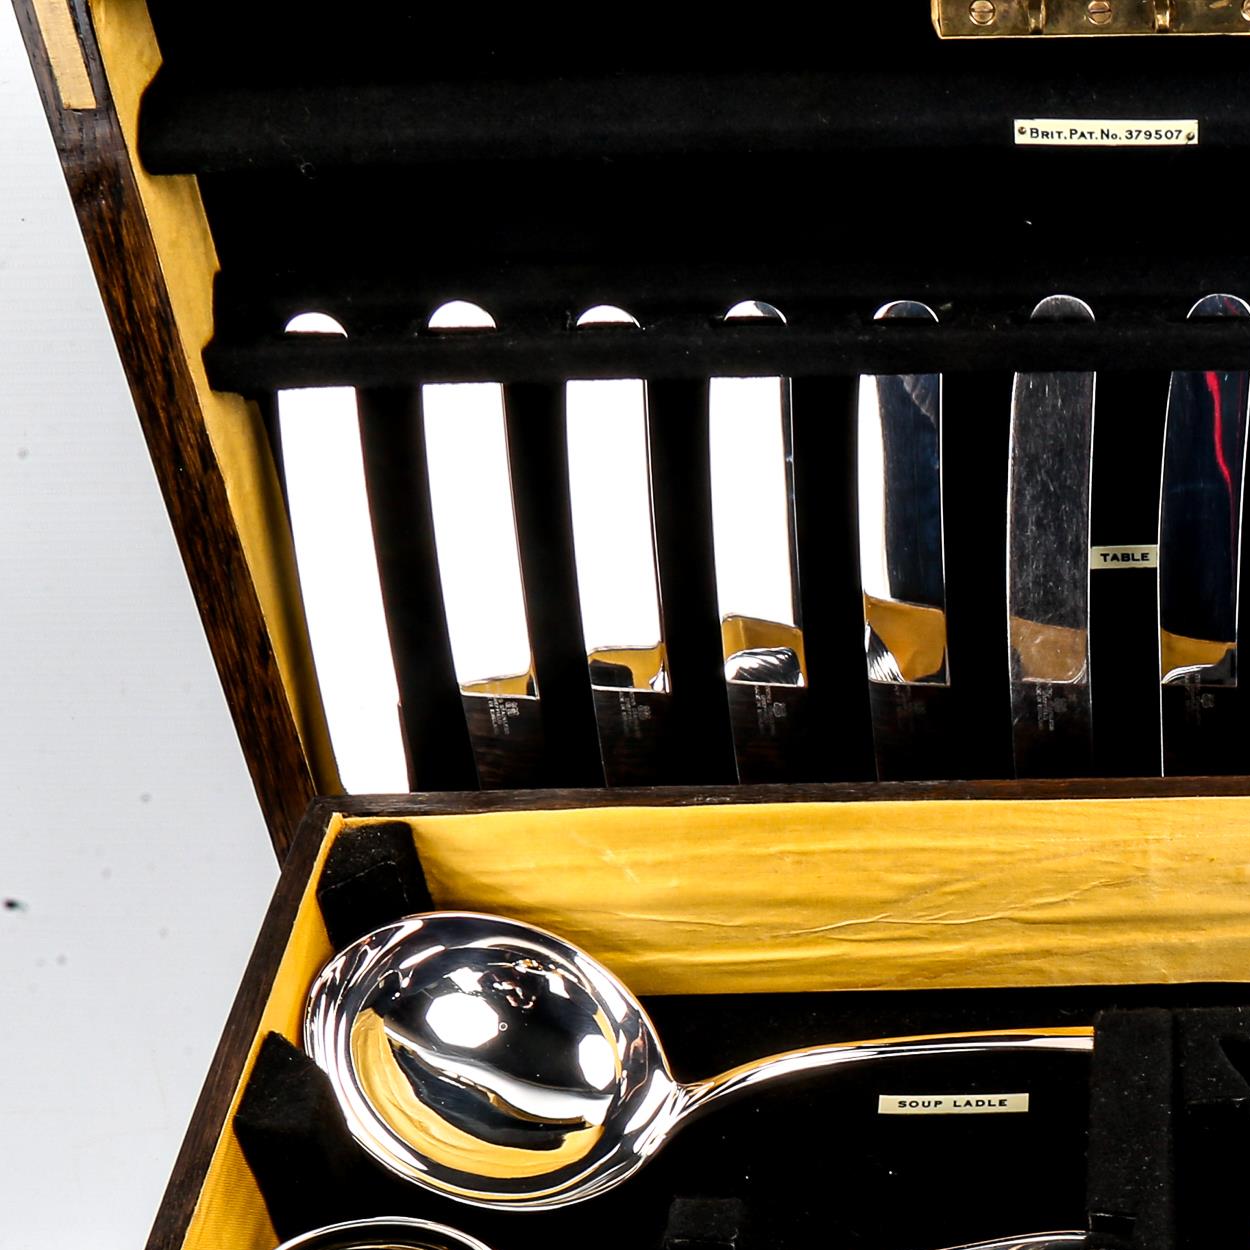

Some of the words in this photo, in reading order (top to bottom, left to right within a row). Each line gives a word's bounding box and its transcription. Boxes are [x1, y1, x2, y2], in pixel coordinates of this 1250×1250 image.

[1100, 552, 1150, 563] TABLE
[898, 1100, 943, 1109] SOUP
[953, 1098, 1008, 1108] LADLE
